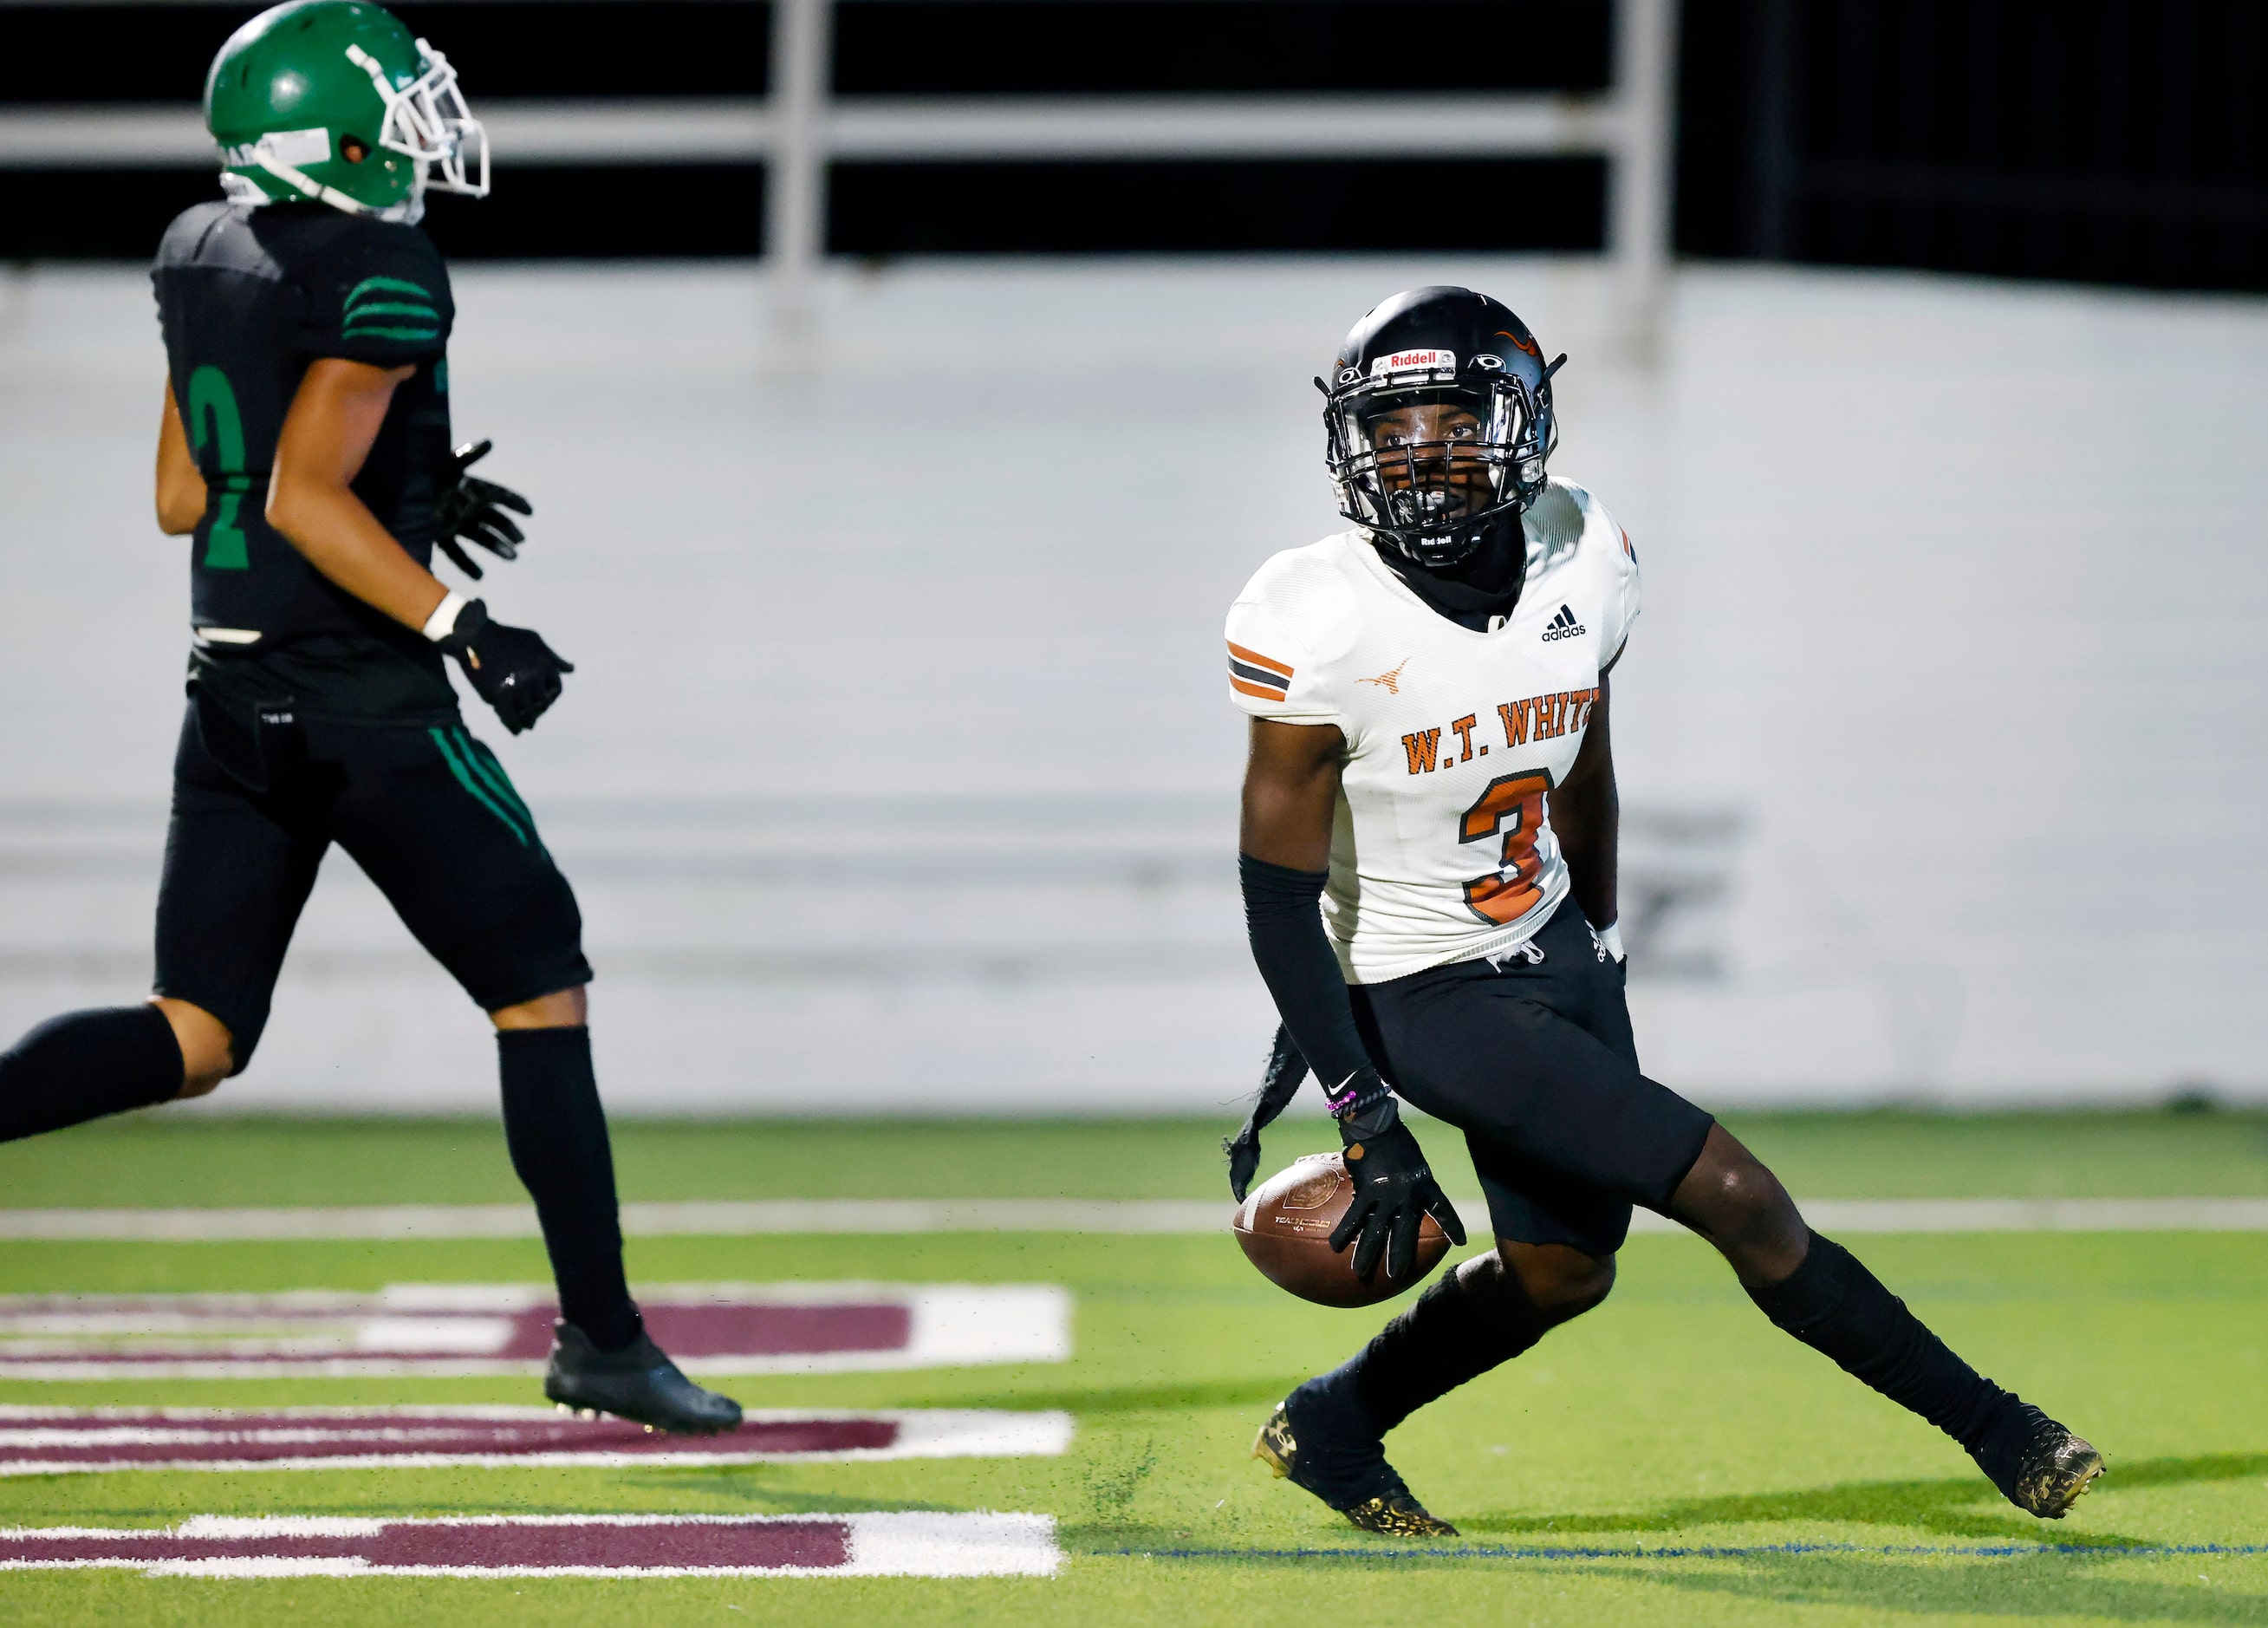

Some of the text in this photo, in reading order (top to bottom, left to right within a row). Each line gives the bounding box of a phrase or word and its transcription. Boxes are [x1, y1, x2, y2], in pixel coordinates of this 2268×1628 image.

[1391, 351, 1436, 368] Riddell
[188, 366, 253, 570] 2
[1420, 535, 1452, 546] Riddell
[1542, 624, 1586, 642] adidas
[1400, 713, 1490, 777] W.T.
[1459, 767, 1555, 928] 3
